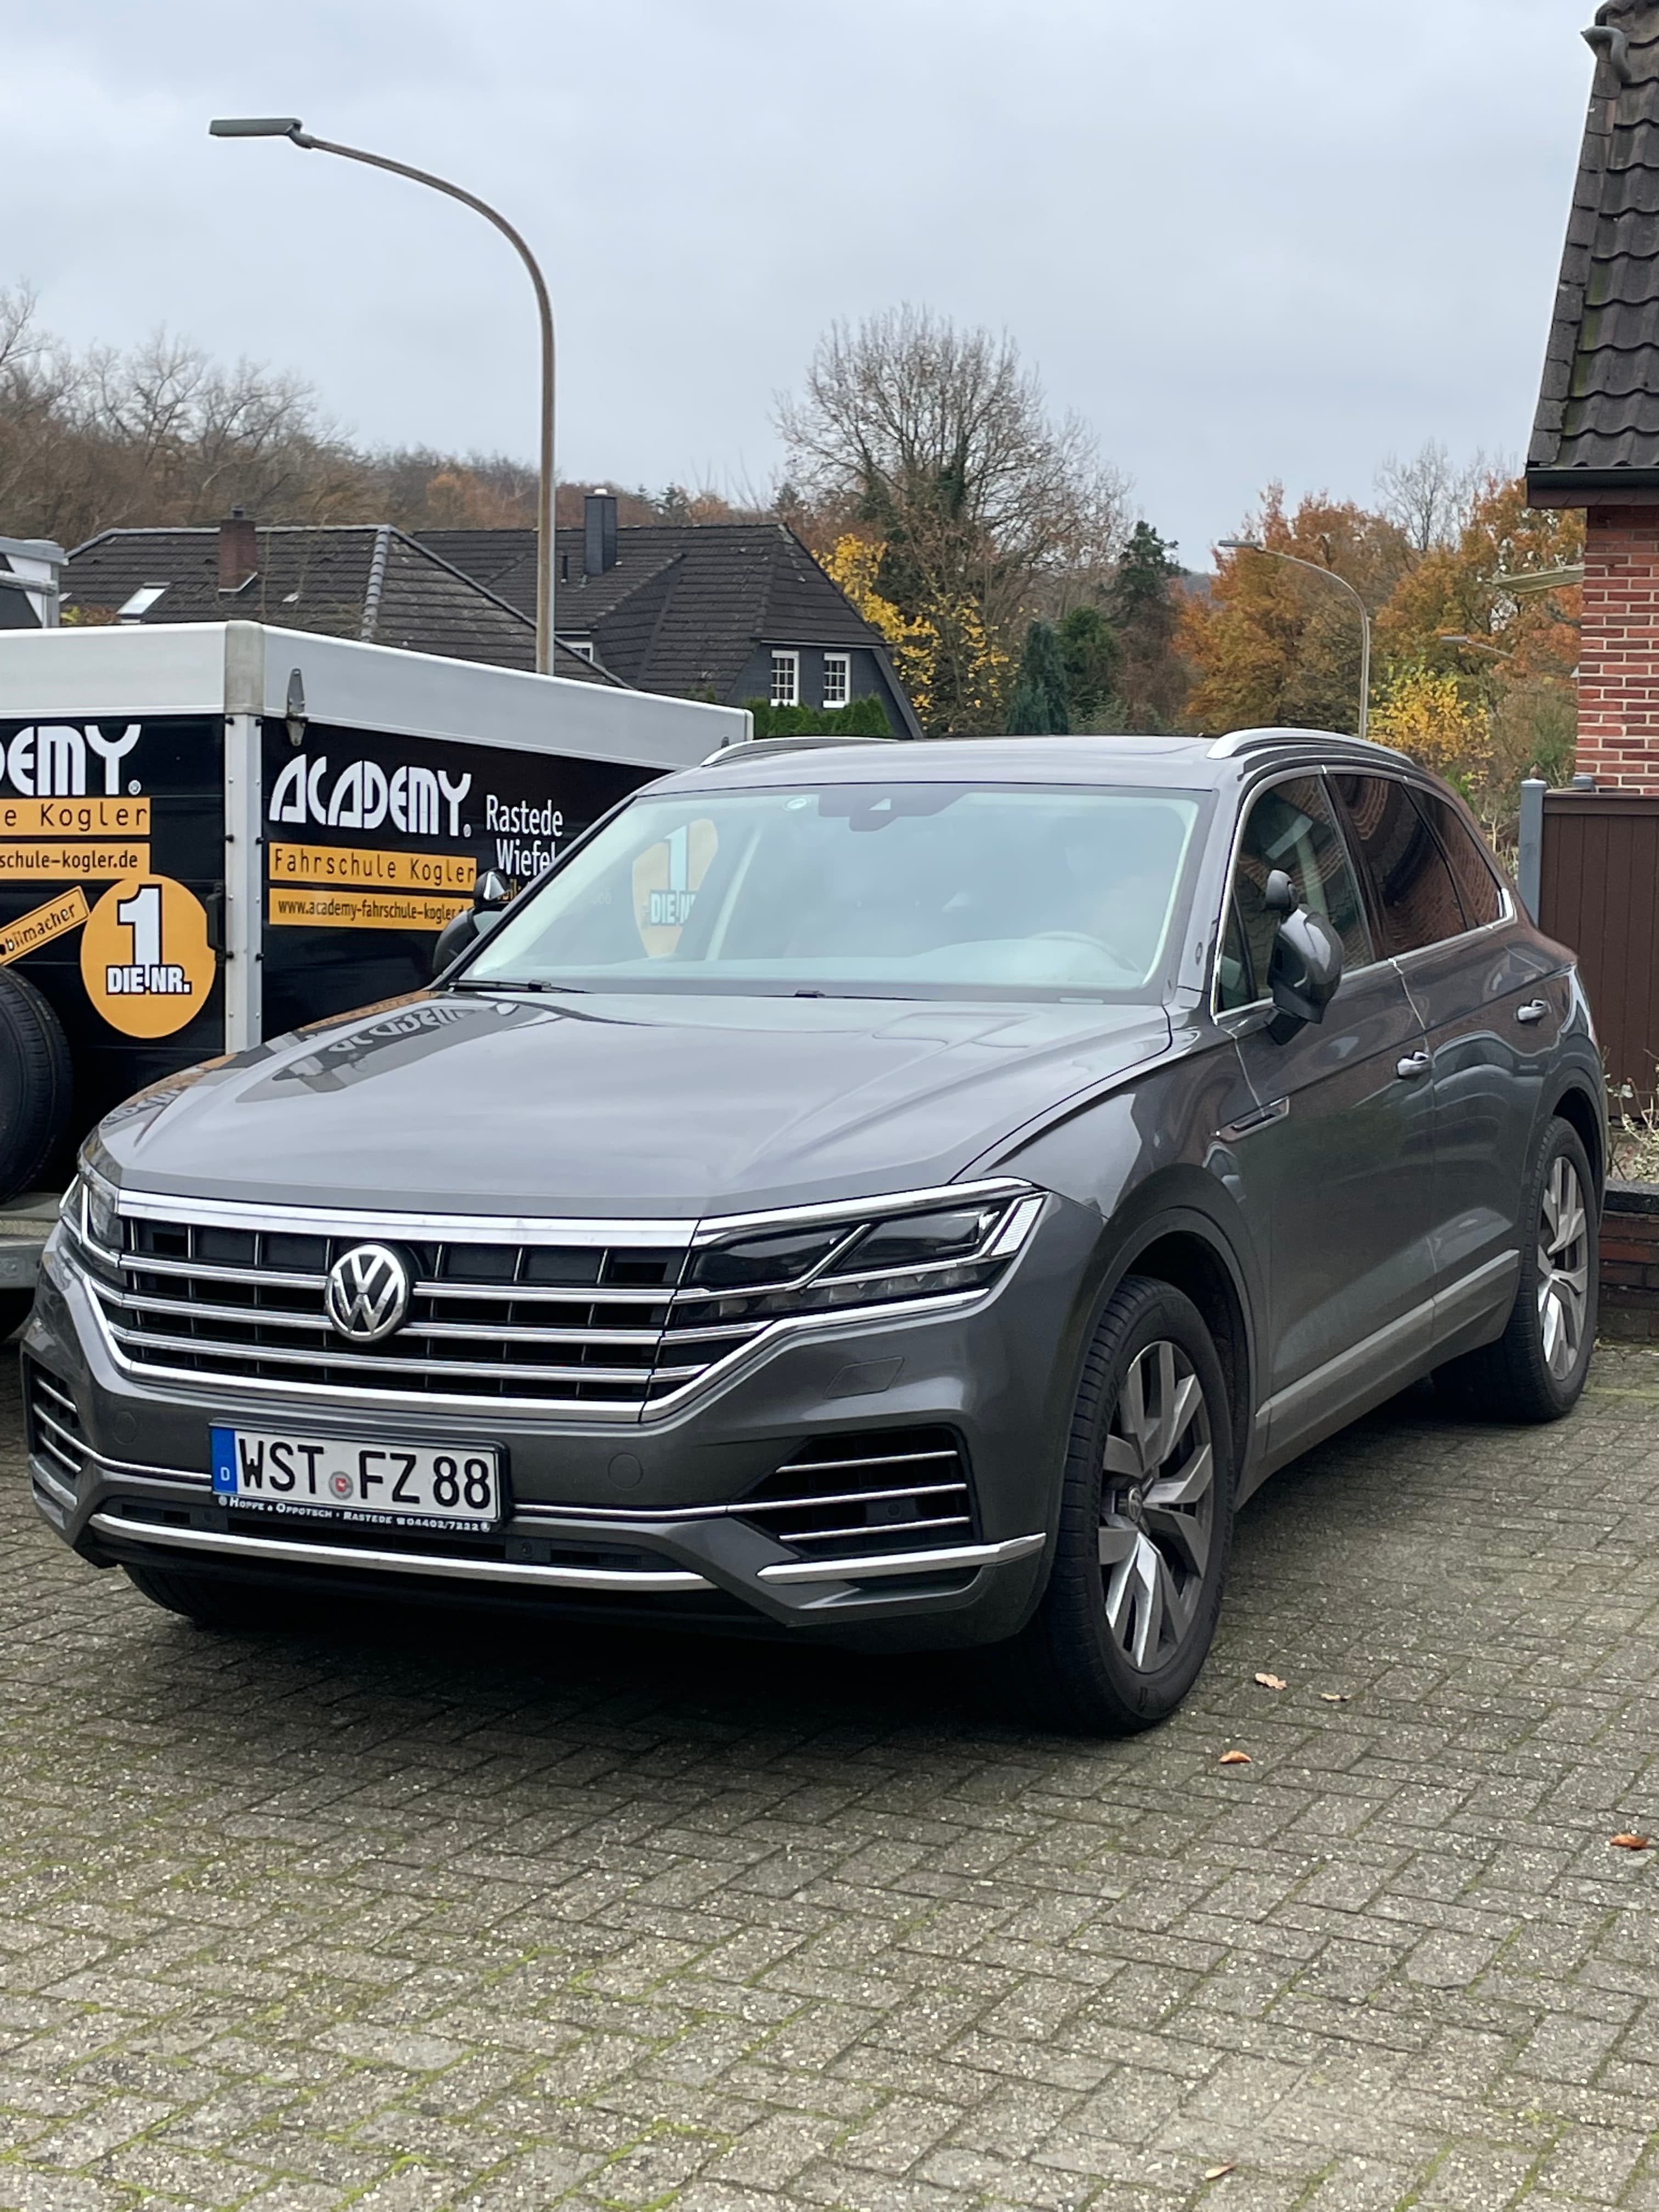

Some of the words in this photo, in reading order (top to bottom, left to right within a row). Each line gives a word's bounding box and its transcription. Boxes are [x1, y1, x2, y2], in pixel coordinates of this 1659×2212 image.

[0, 724, 142, 795] EMY
[41, 803, 147, 832] Kogler
[486, 794, 563, 837] Rastede
[275, 848, 396, 878] Fahrschule
[410, 857, 474, 886] Kogler
[278, 898, 464, 924] www.academy-fahrschule-kogler
[108, 967, 144, 992] DIE
[151, 967, 190, 992] NR.
[328, 1243, 406, 1341] VW
[221, 1467, 230, 1481] D
[239, 1438, 324, 1494] WST
[359, 1450, 421, 1504] FZ
[433, 1456, 492, 1510] 88
